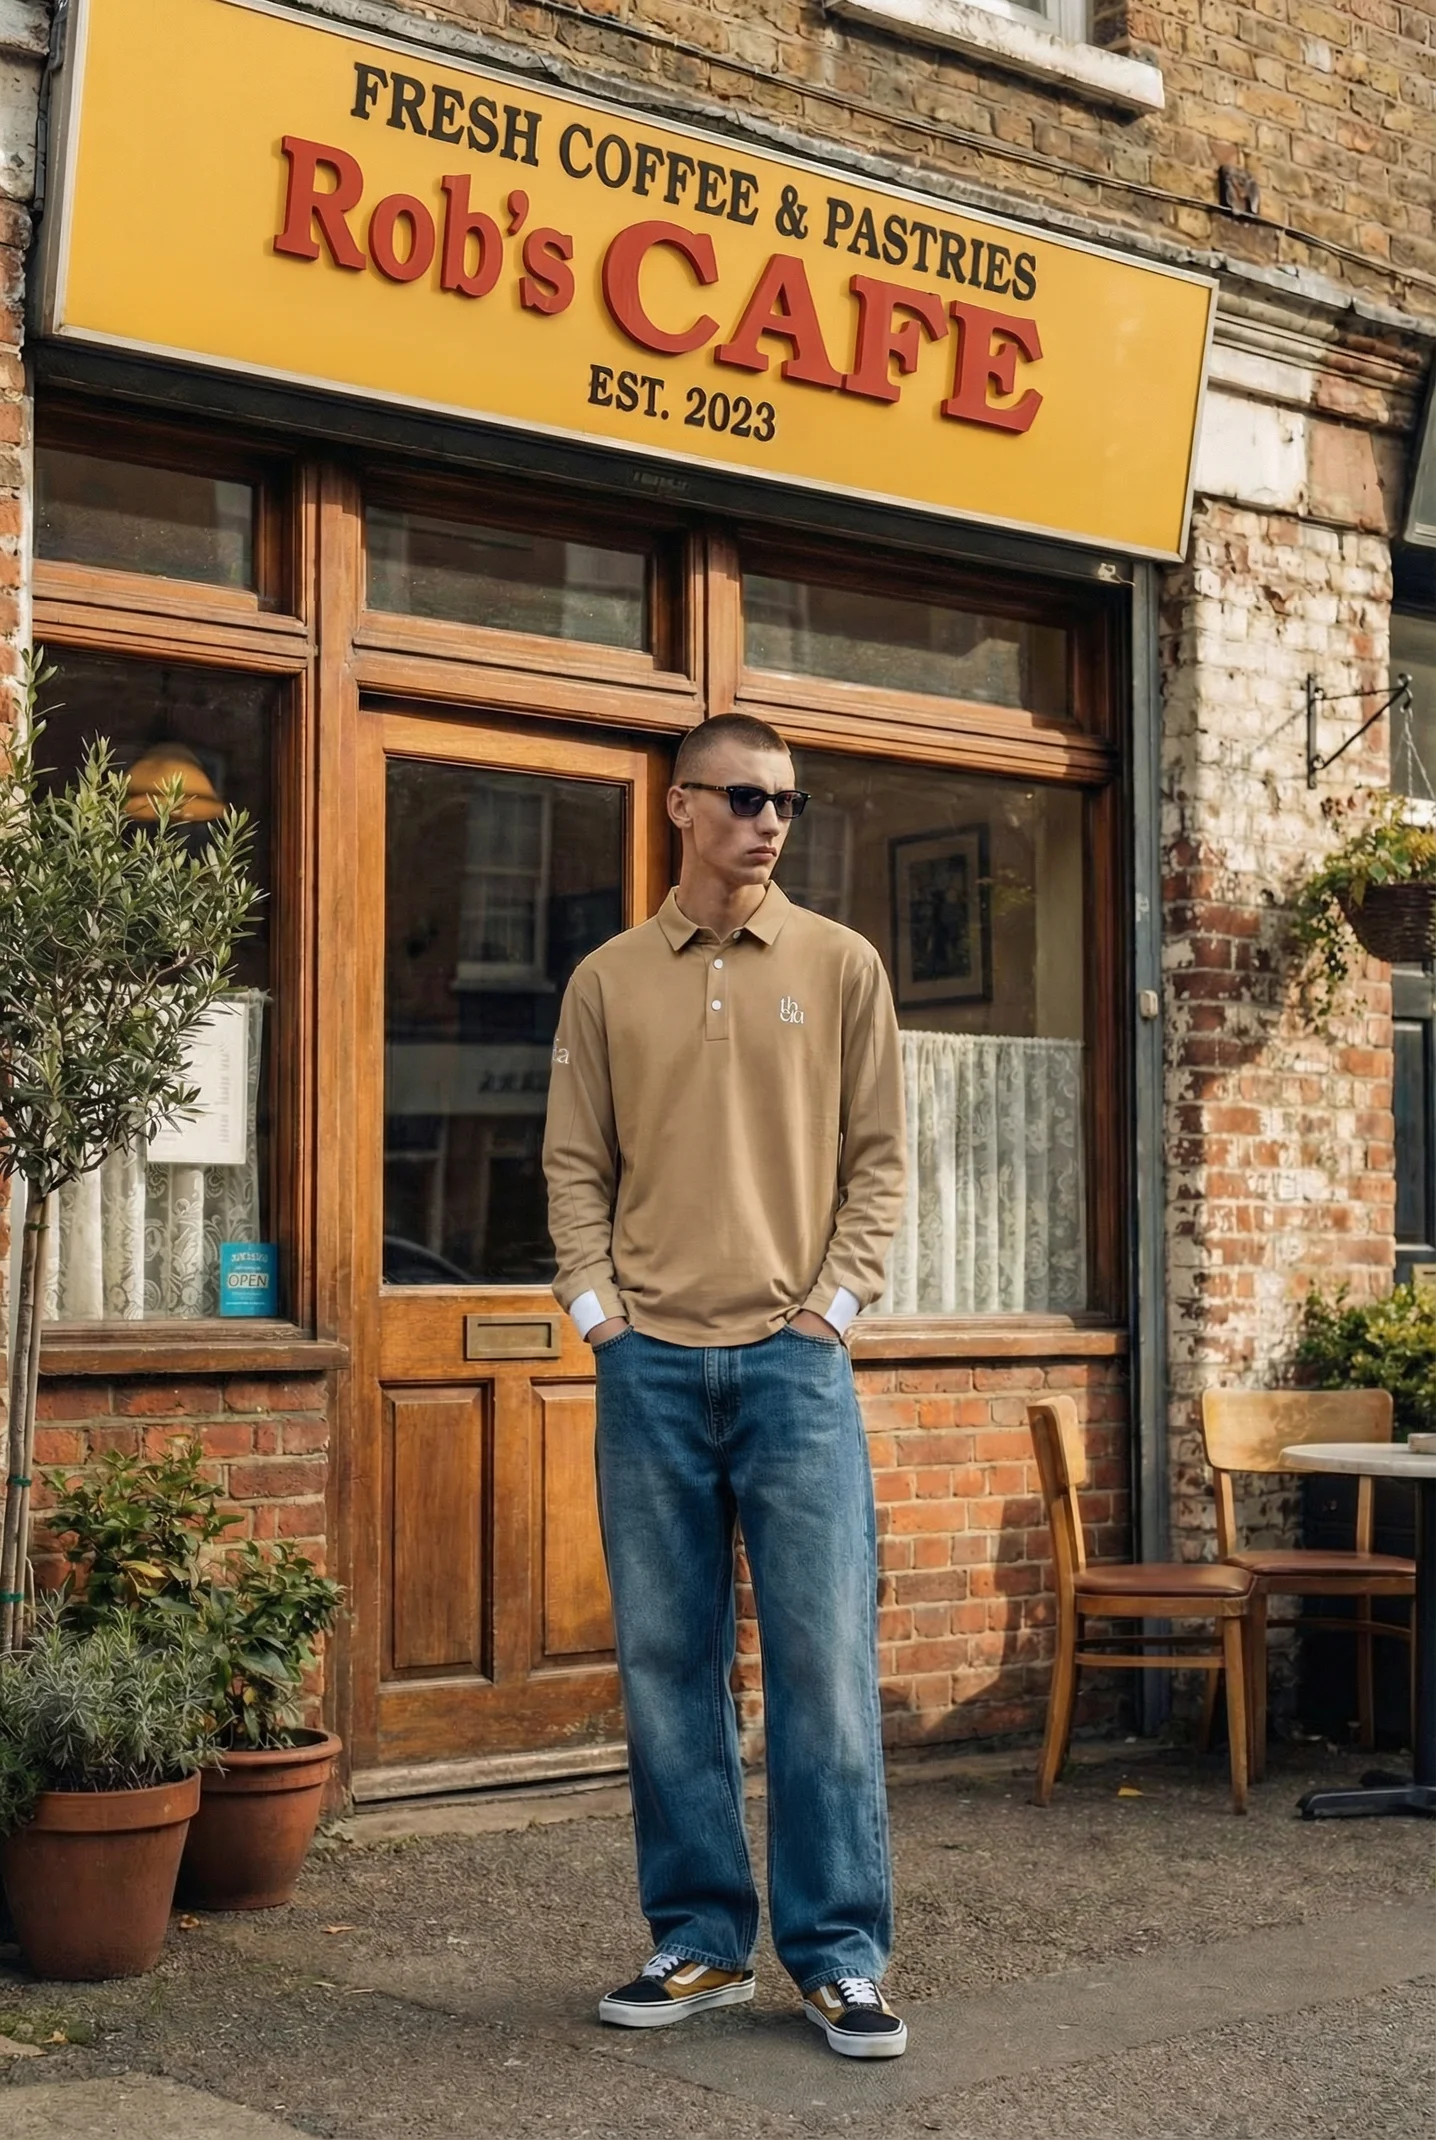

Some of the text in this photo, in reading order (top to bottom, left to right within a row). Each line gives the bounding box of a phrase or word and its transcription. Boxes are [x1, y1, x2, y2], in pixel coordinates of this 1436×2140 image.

[350, 61, 1037, 301] FRESH COFFEE & PASTRIES
[273, 135, 1044, 434] Rob's CAFE
[587, 363, 777, 443] EST. 2023
[228, 1274, 268, 1287] OPEN
